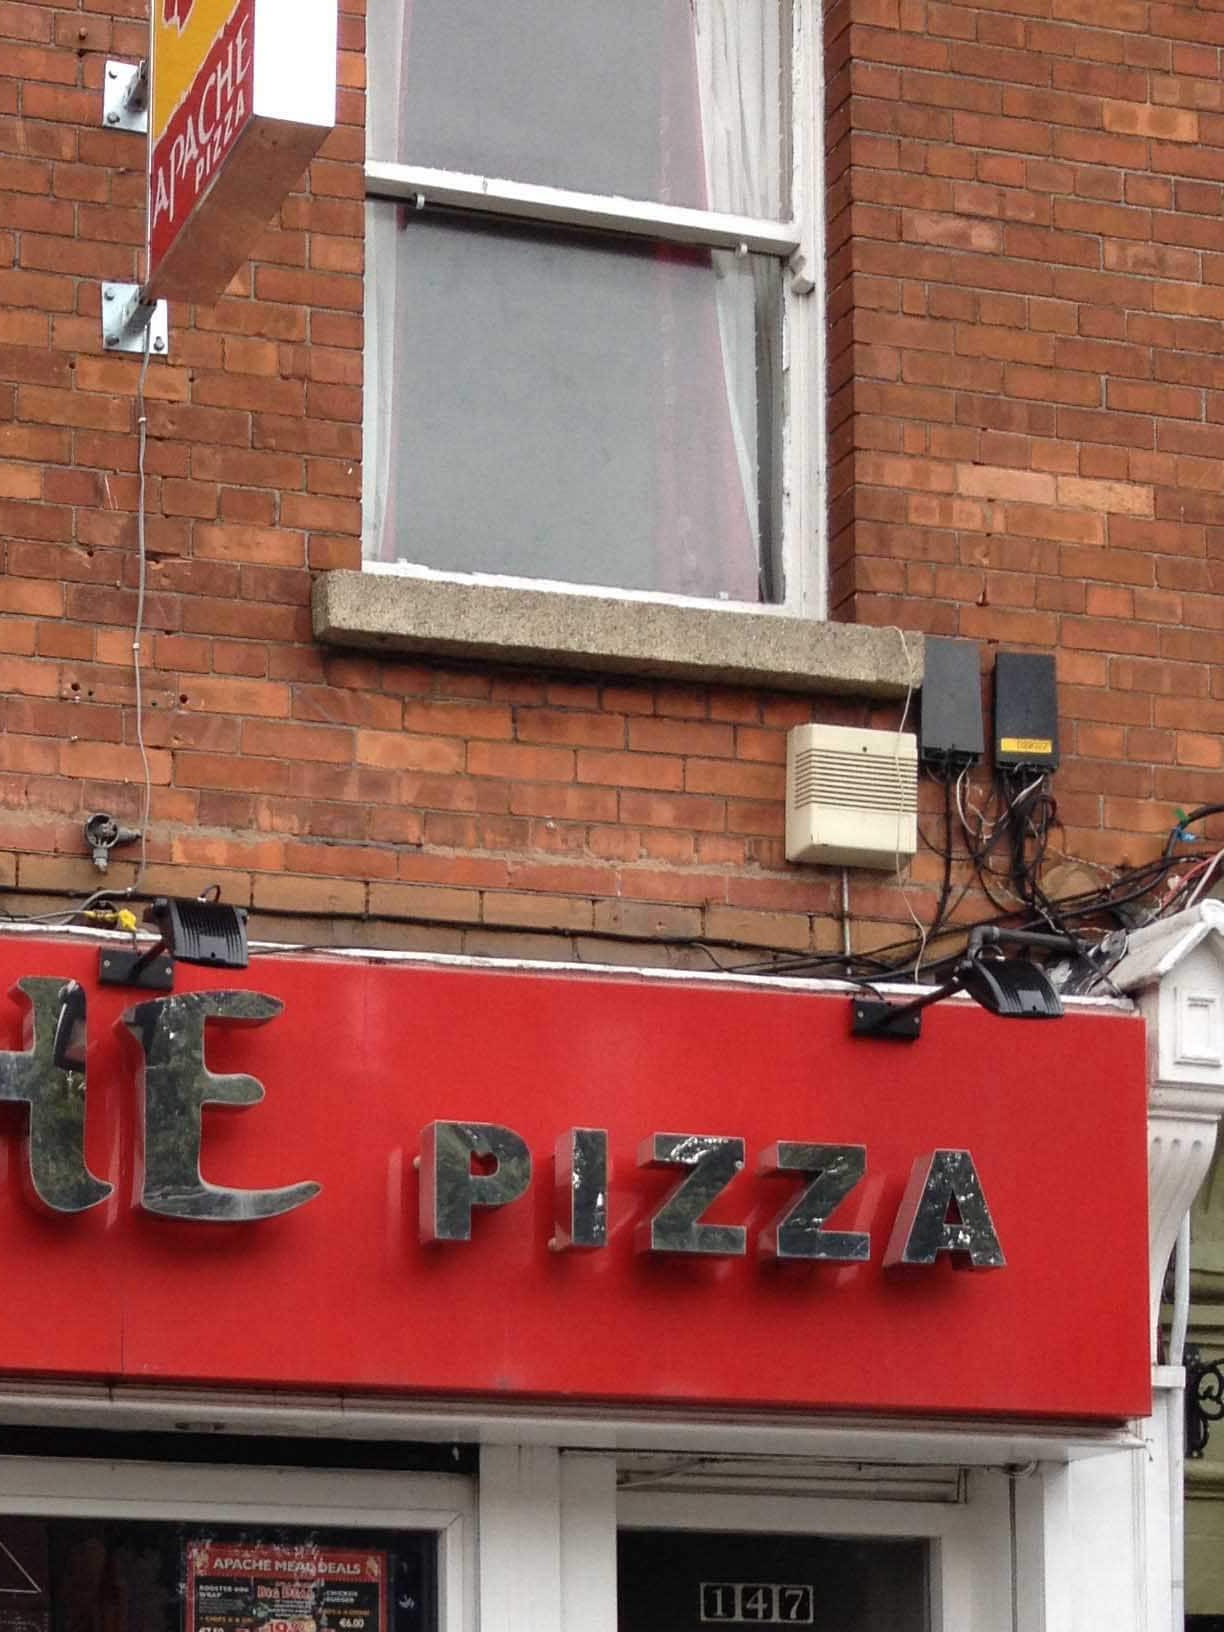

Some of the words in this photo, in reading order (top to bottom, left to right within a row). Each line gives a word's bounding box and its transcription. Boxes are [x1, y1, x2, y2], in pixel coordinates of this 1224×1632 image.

[152, 13, 252, 229] APACHE
[194, 90, 245, 194] PIZZA
[418, 1119, 1007, 1270] PIZZA
[213, 1557, 272, 1571] APACHE
[275, 1559, 316, 1573] MEAL
[318, 1562, 361, 1575] DEALS
[339, 1617, 365, 1629] €6.00
[712, 1588, 805, 1620] 147
